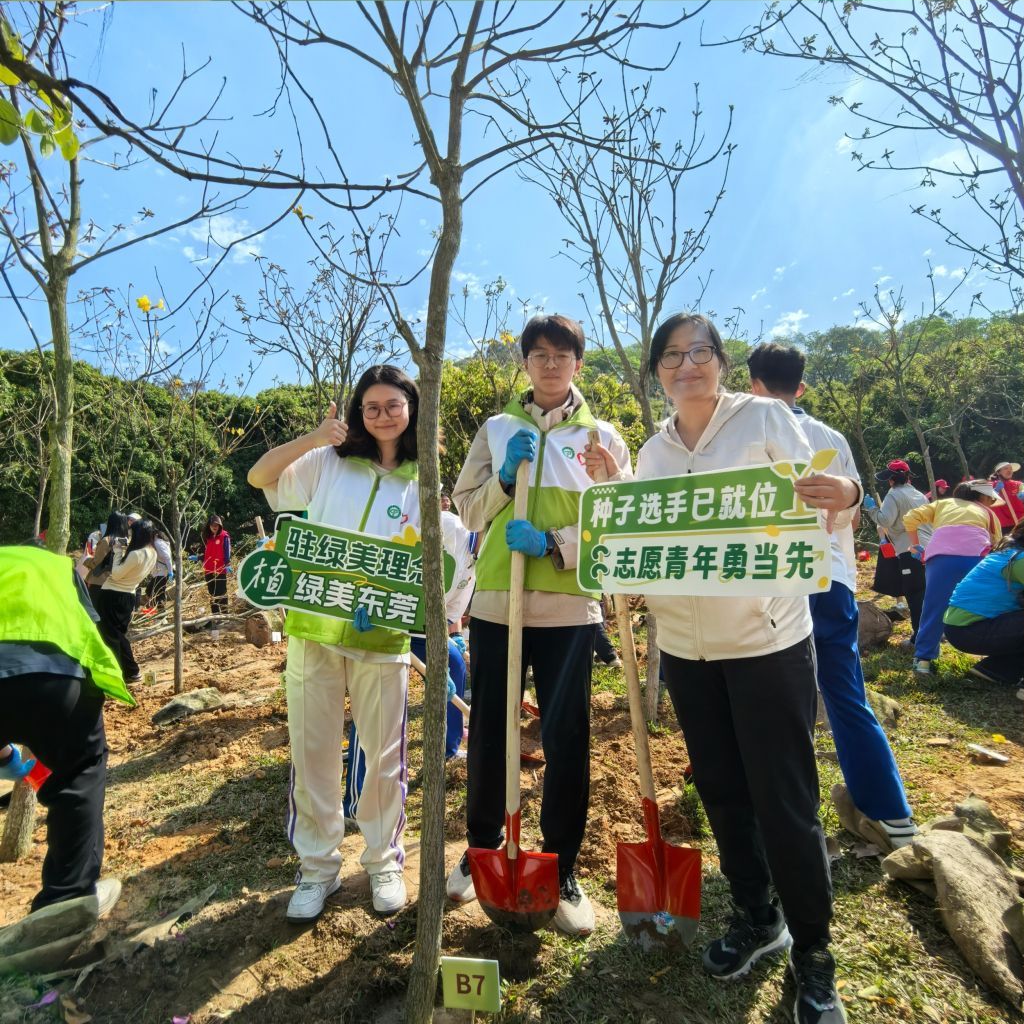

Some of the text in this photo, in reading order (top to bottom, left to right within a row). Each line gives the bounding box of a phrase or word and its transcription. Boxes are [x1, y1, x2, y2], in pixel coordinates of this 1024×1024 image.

[590, 481, 778, 528] 种子选手已就位
[612, 541, 815, 581] 志愿青年勇当先
[456, 973, 486, 996] B7
